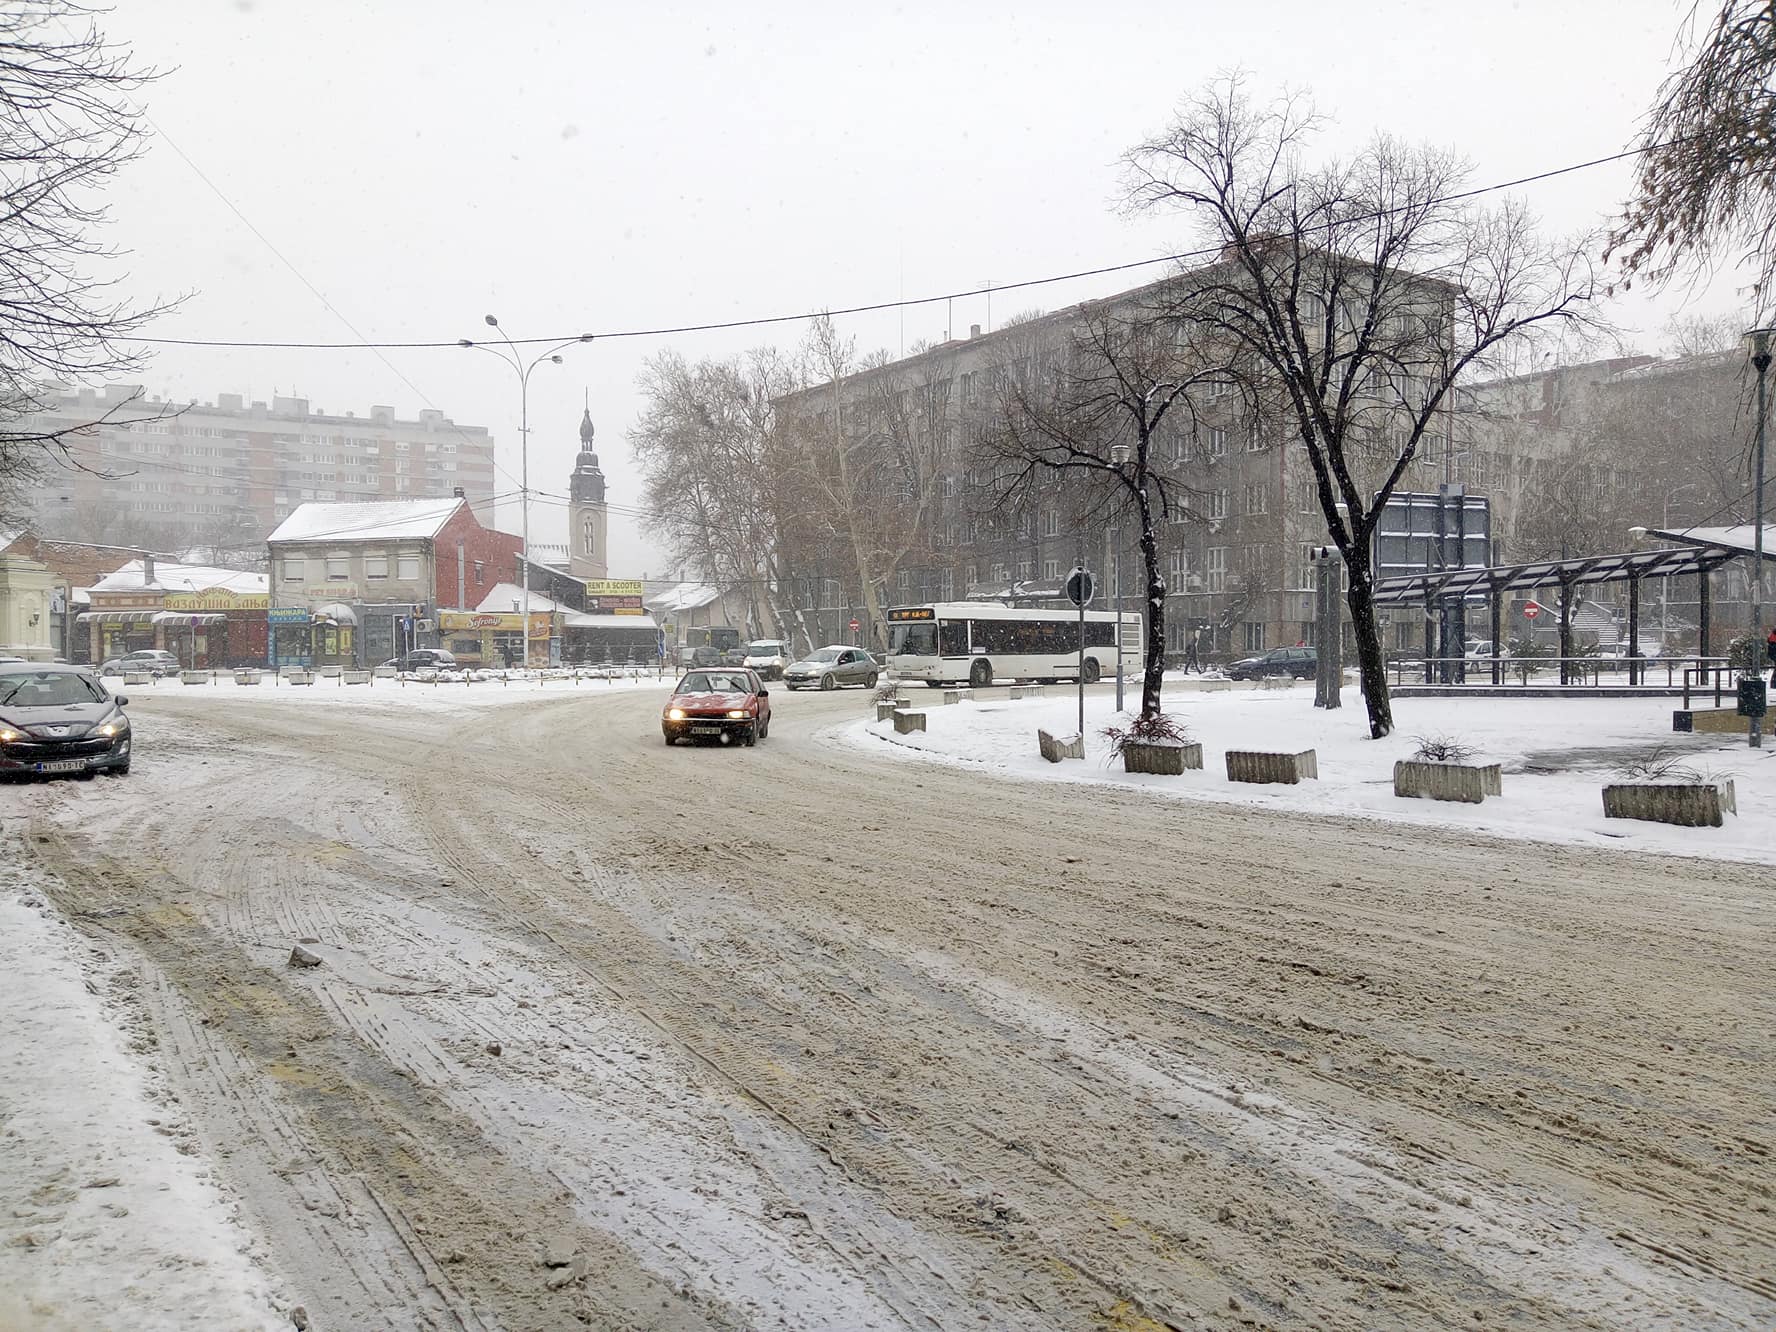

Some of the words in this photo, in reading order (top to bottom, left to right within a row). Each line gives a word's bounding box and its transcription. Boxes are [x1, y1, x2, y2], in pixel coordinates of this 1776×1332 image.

[588, 581, 604, 589] RENT
[606, 581, 611, 589] A
[612, 581, 641, 589] SCOOTER
